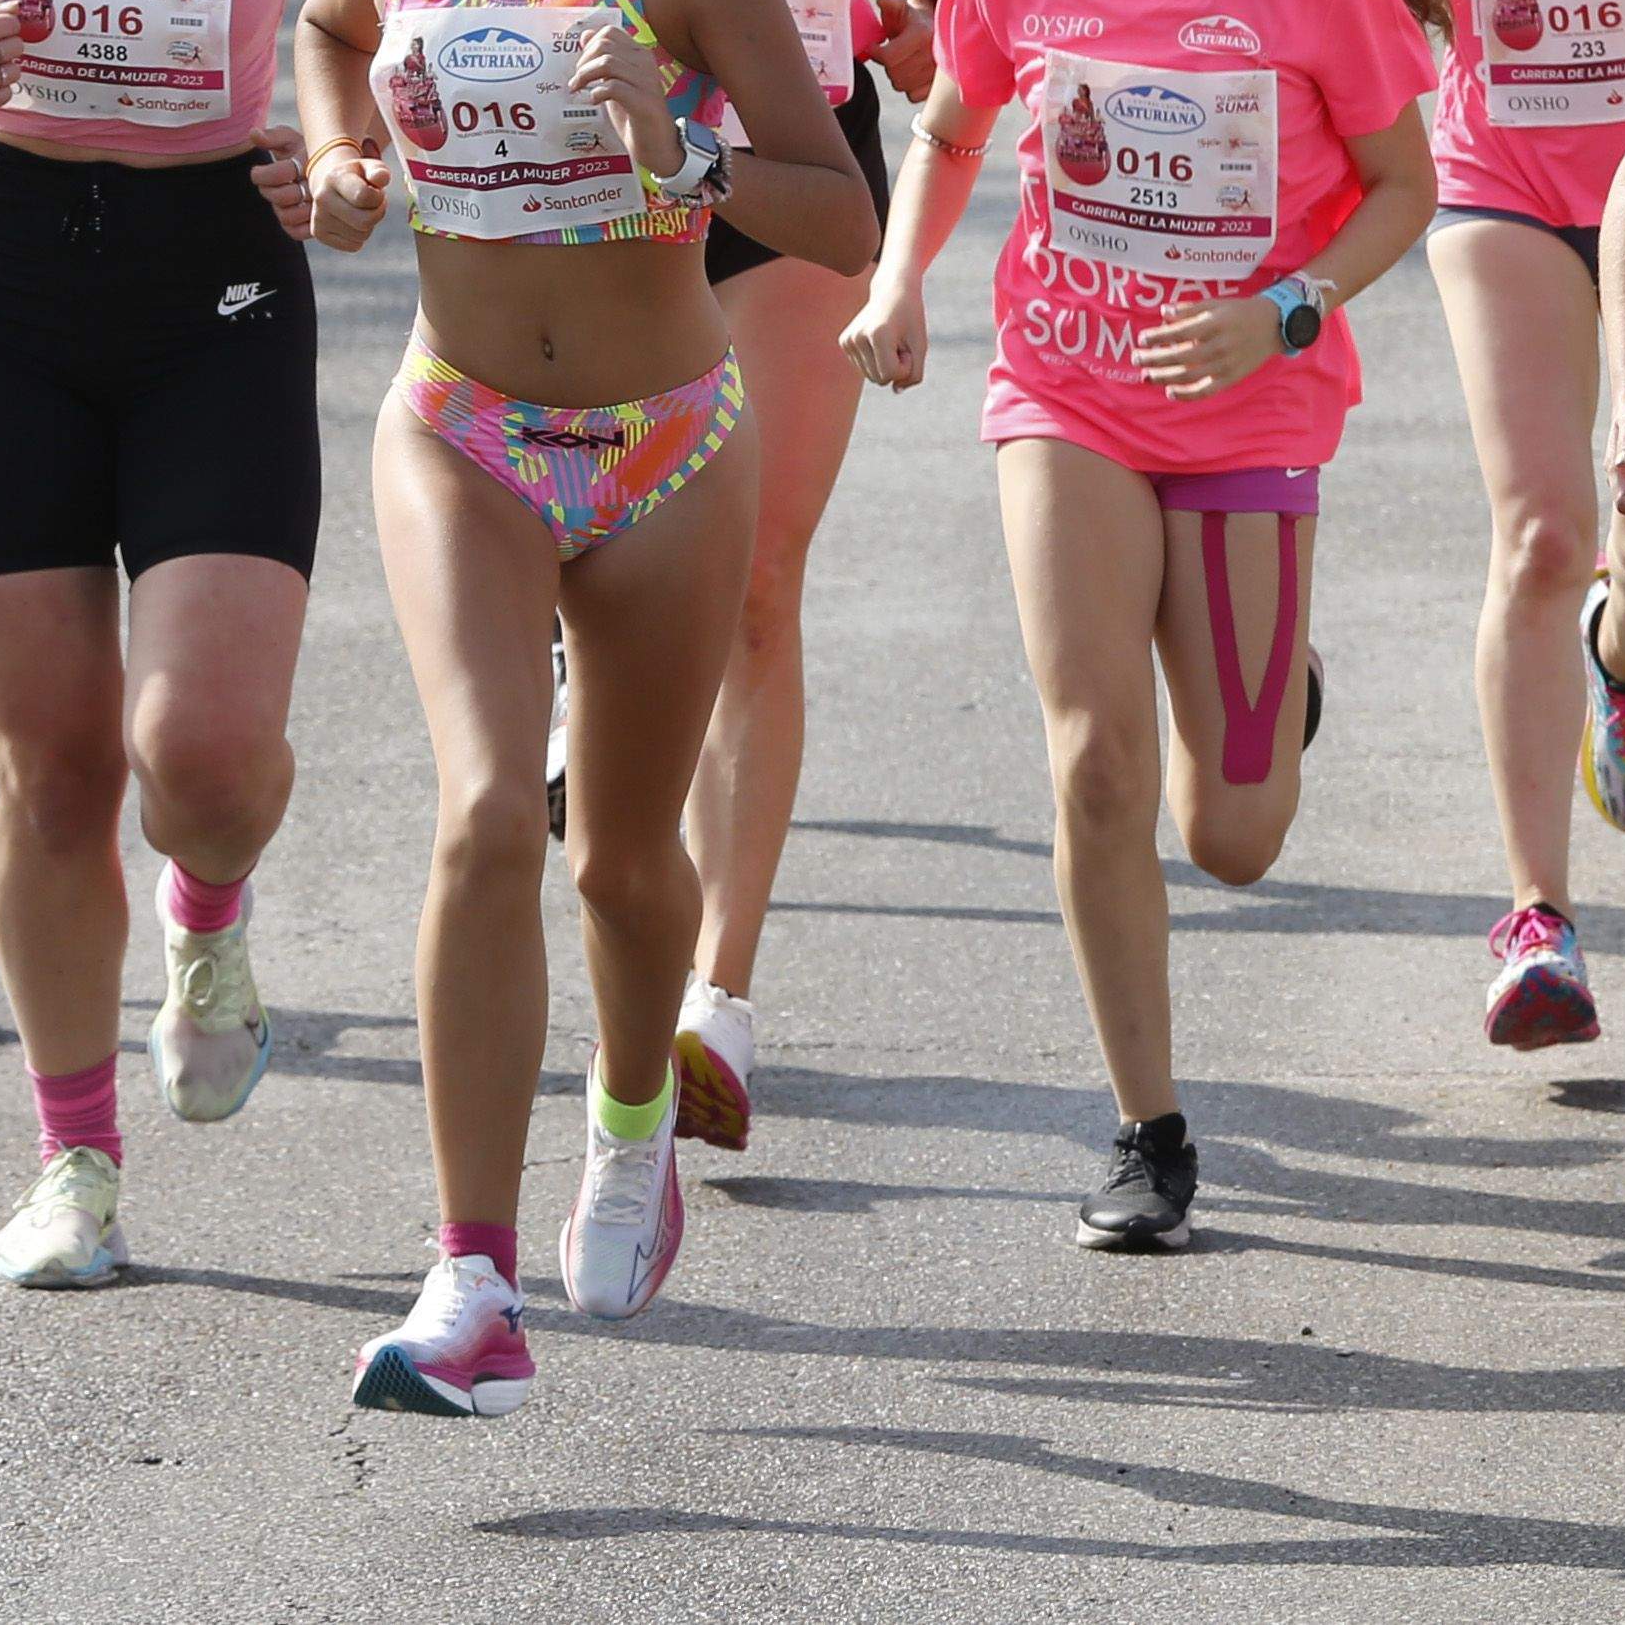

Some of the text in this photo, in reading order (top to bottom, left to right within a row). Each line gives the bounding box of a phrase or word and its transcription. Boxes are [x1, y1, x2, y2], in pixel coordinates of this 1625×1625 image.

[62, 2, 143, 35] 016
[1024, 14, 1104, 38] OYSHO
[1548, 2, 1622, 32] 016
[1186, 28, 1256, 51] ASTURIANA
[1570, 40, 1606, 58] 233
[77, 43, 128, 61] 4388
[446, 48, 536, 68] ASTURIANA
[78, 68, 97, 78] DE
[100, 70, 117, 80] LA
[120, 71, 167, 82] MUJER
[173, 75, 204, 86] 2023
[1511, 68, 1566, 80] CARRERA
[1568, 68, 1584, 78] DE
[1588, 67, 1604, 77] LA
[136, 98, 211, 111] Santander
[1114, 98, 1198, 126] ASTURIANA
[1215, 102, 1259, 114] SUMA
[1508, 96, 1569, 110] OYSHO
[452, 102, 536, 132] 016
[495, 140, 508, 157] 4
[426, 161, 610, 185] CARRERA DE LA MUJER 2023
[1116, 147, 1193, 182] 016
[431, 188, 622, 220] OYSHO Santander
[1130, 187, 1178, 208] 2513
[1072, 201, 1252, 232] CARRERA DE LA MUJER 2023
[1070, 226, 1258, 262] OYSHO Santander
[225, 282, 261, 302] NIKE
[1024, 298, 1135, 362] SUM
